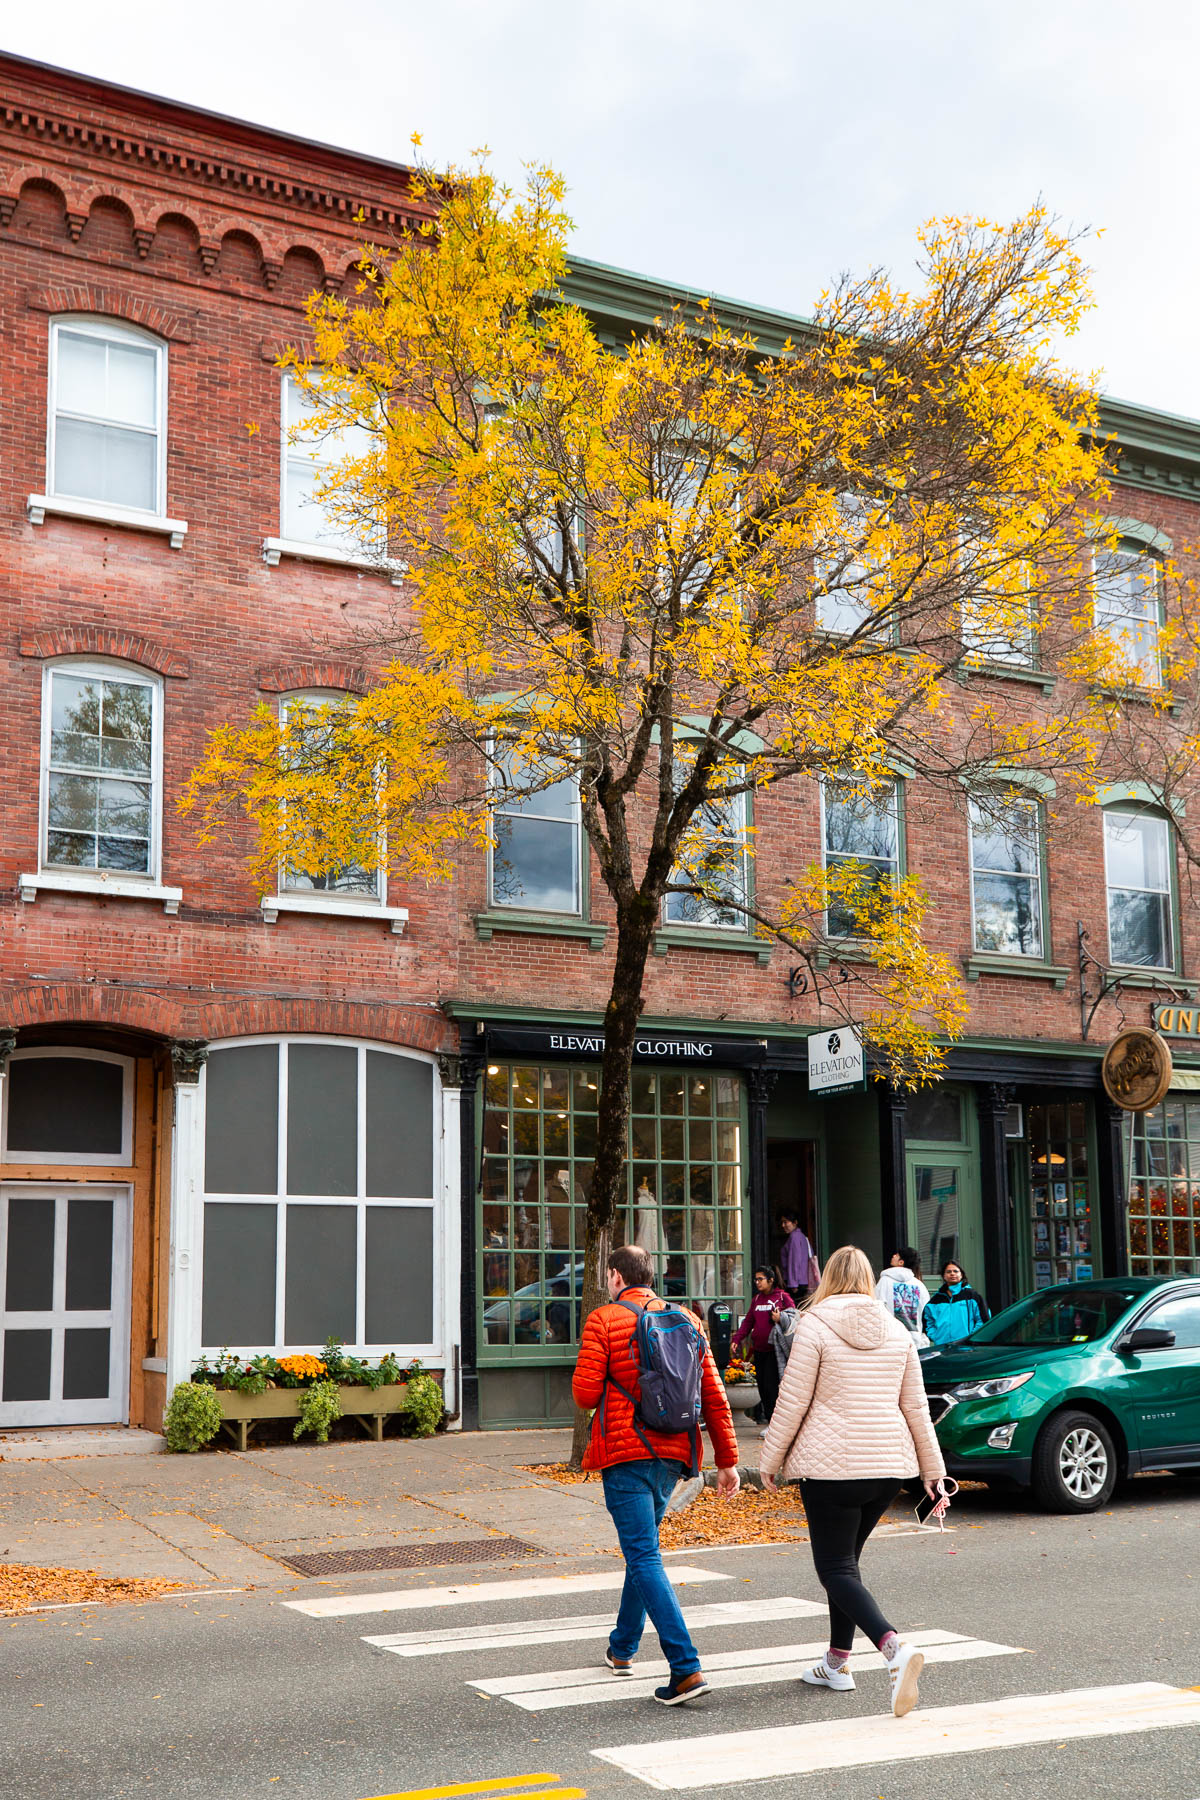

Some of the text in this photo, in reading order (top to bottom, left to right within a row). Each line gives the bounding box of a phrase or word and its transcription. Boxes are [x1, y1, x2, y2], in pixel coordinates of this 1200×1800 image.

[550, 1035, 713, 1057] ELEVATI CLOTHING
[810, 1055, 861, 1077] ELEVATION
[821, 1071, 850, 1083] CLOTHING
